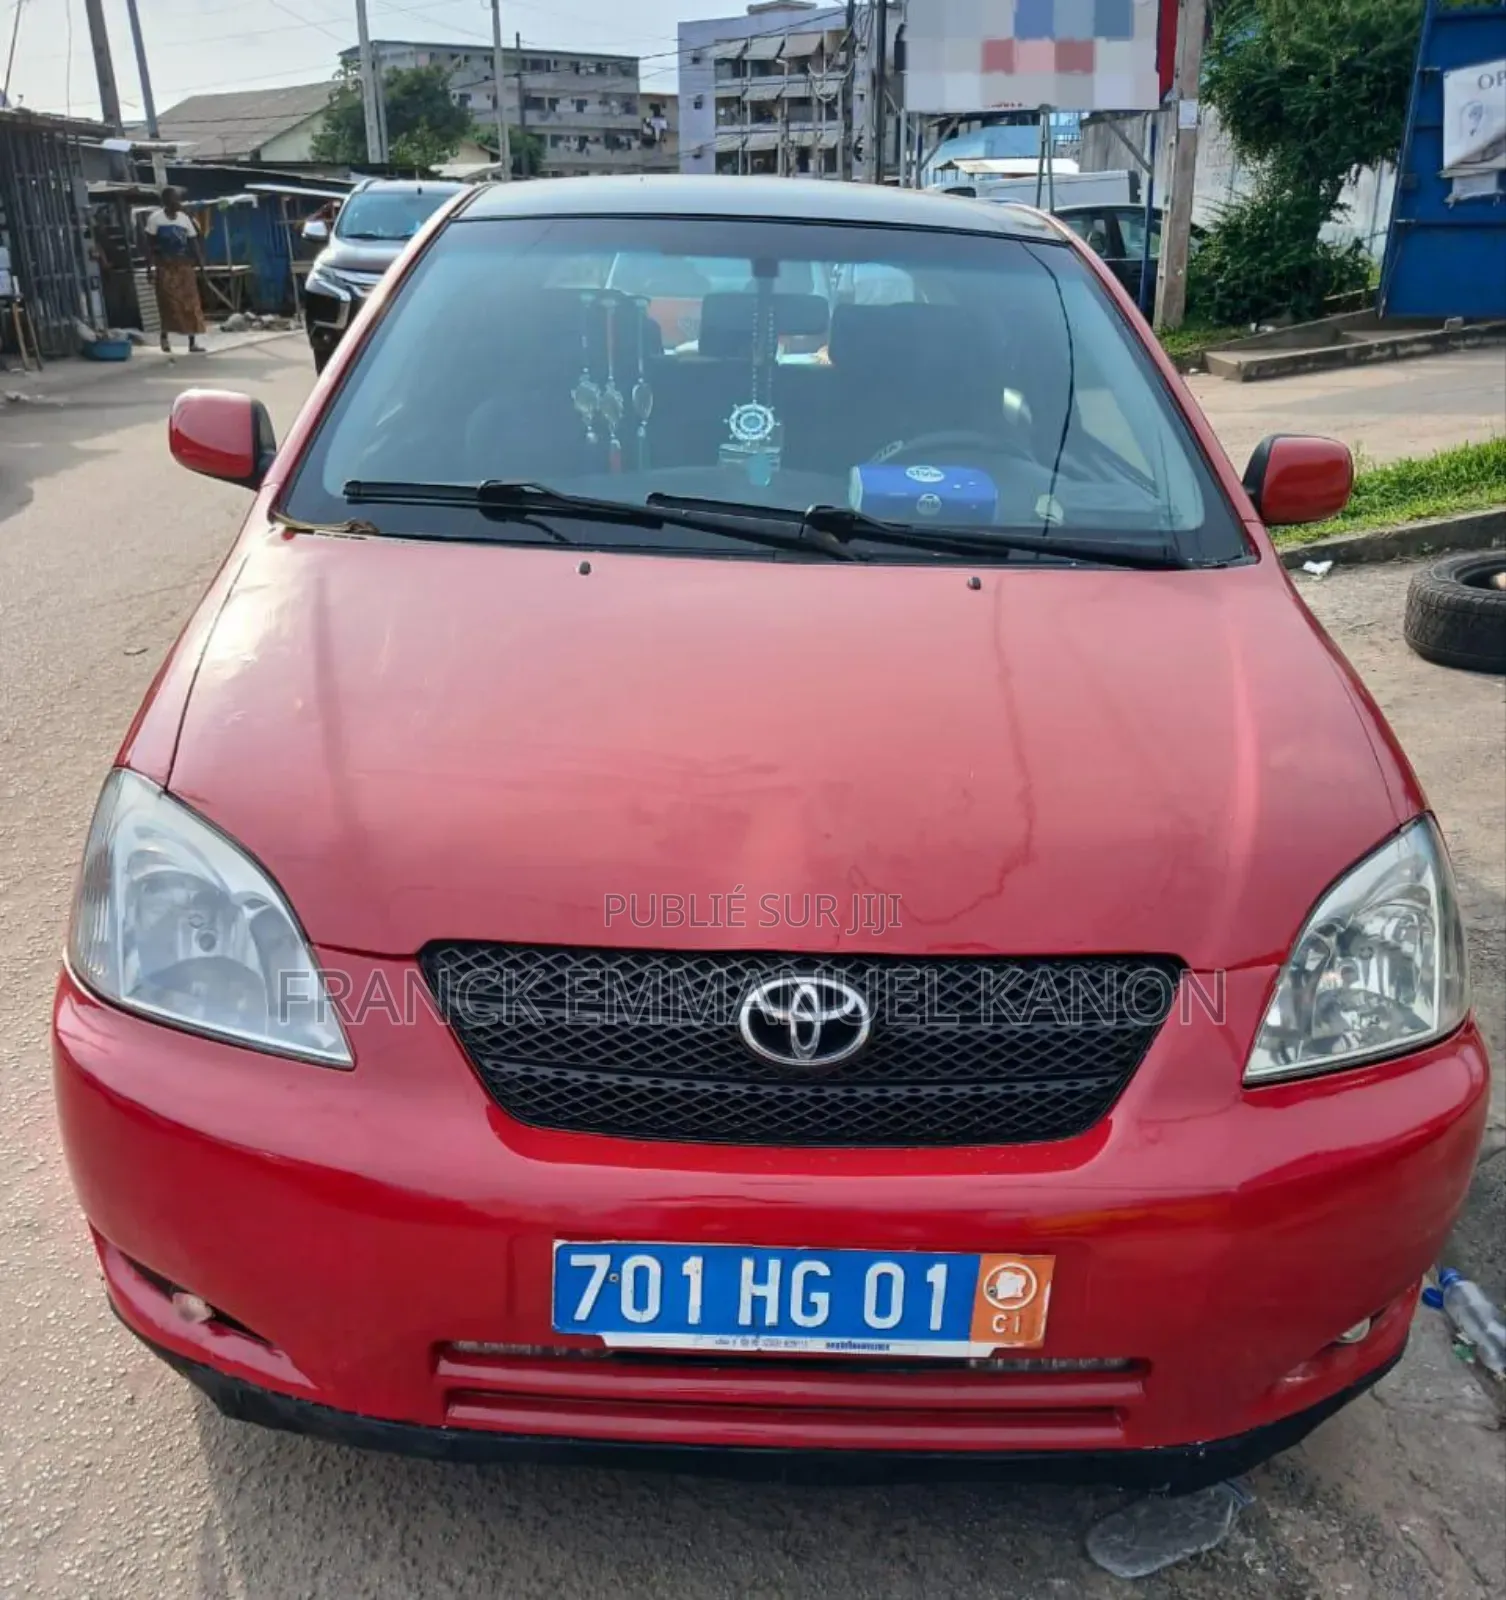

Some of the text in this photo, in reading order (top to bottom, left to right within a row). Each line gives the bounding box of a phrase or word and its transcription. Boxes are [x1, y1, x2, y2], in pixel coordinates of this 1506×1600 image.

[570, 1254, 948, 1331] 701 HG 01
[992, 1314, 1020, 1333] CI
